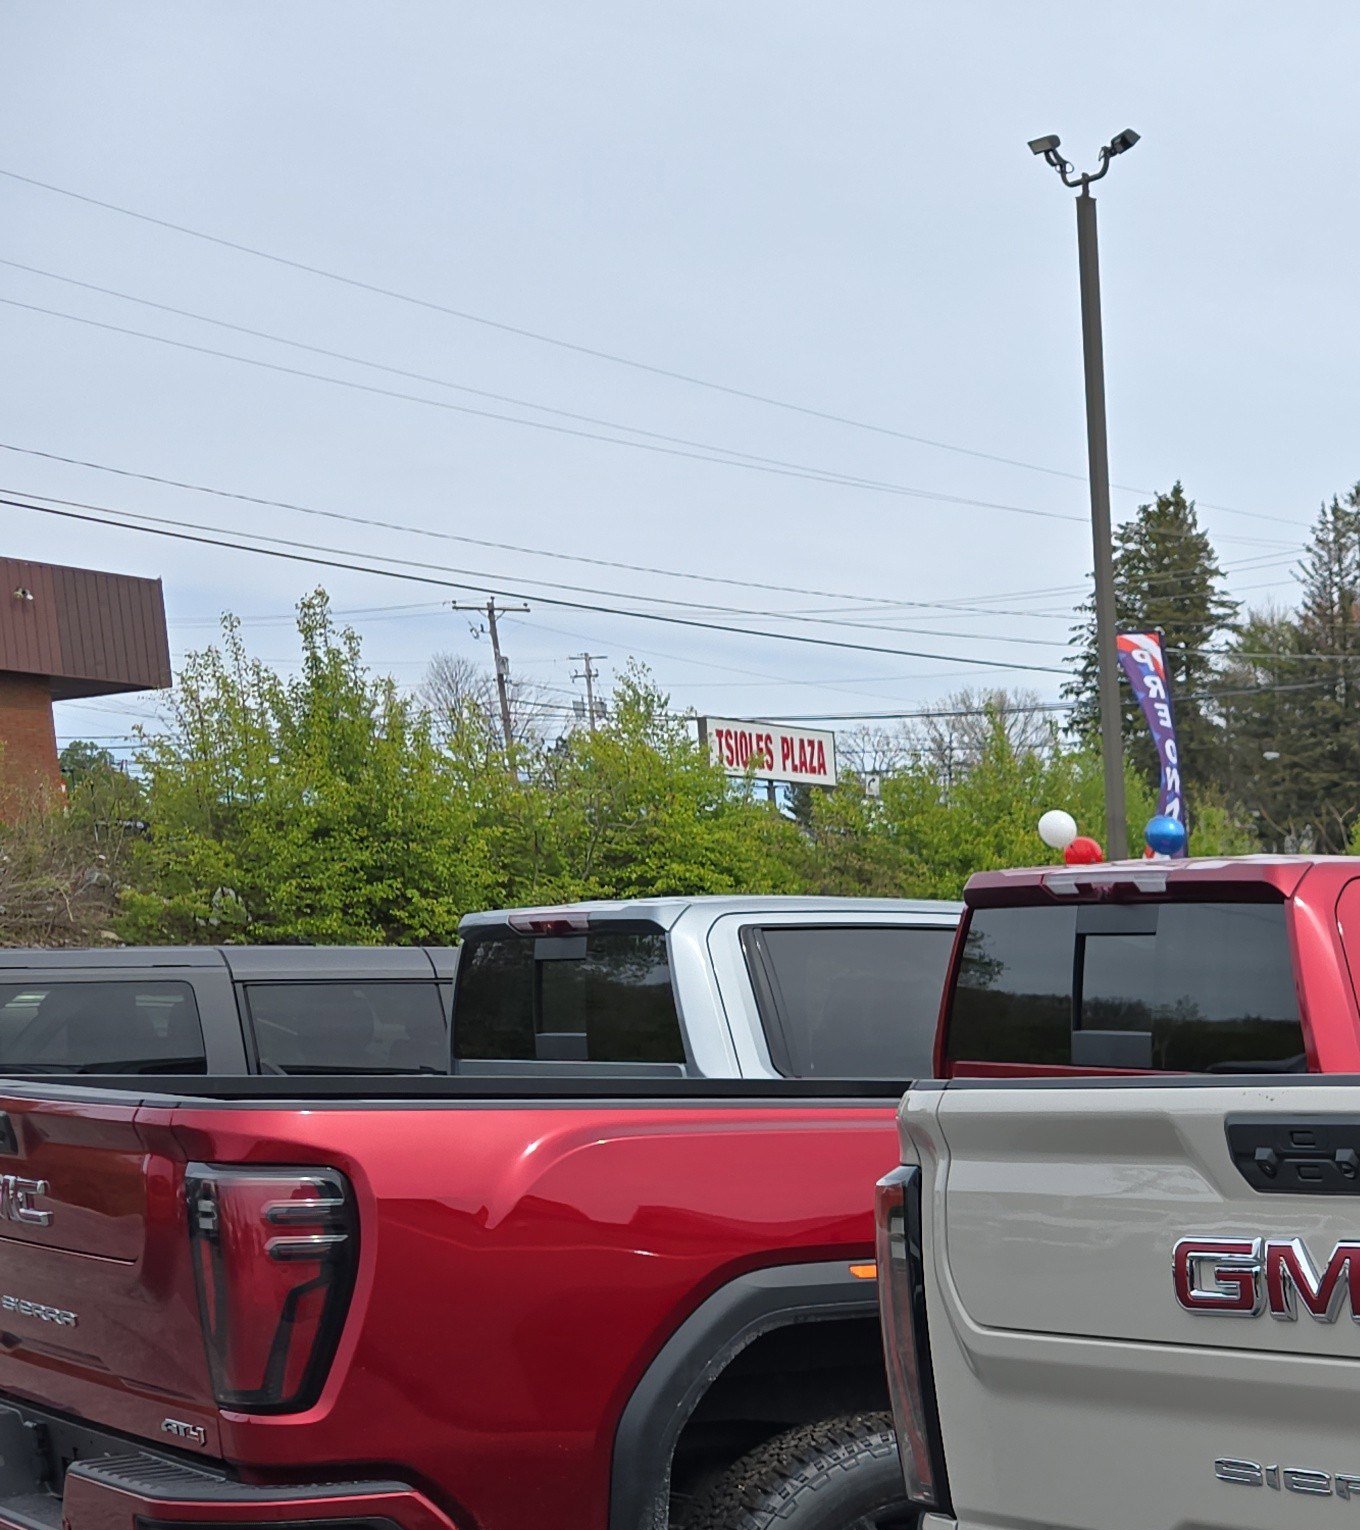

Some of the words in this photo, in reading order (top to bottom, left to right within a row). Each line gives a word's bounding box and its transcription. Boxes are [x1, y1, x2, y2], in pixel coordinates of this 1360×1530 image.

[780, 735, 827, 776] PLAZA
[2, 1294, 78, 1328] SIERRA
[161, 1418, 206, 1446] AT4
